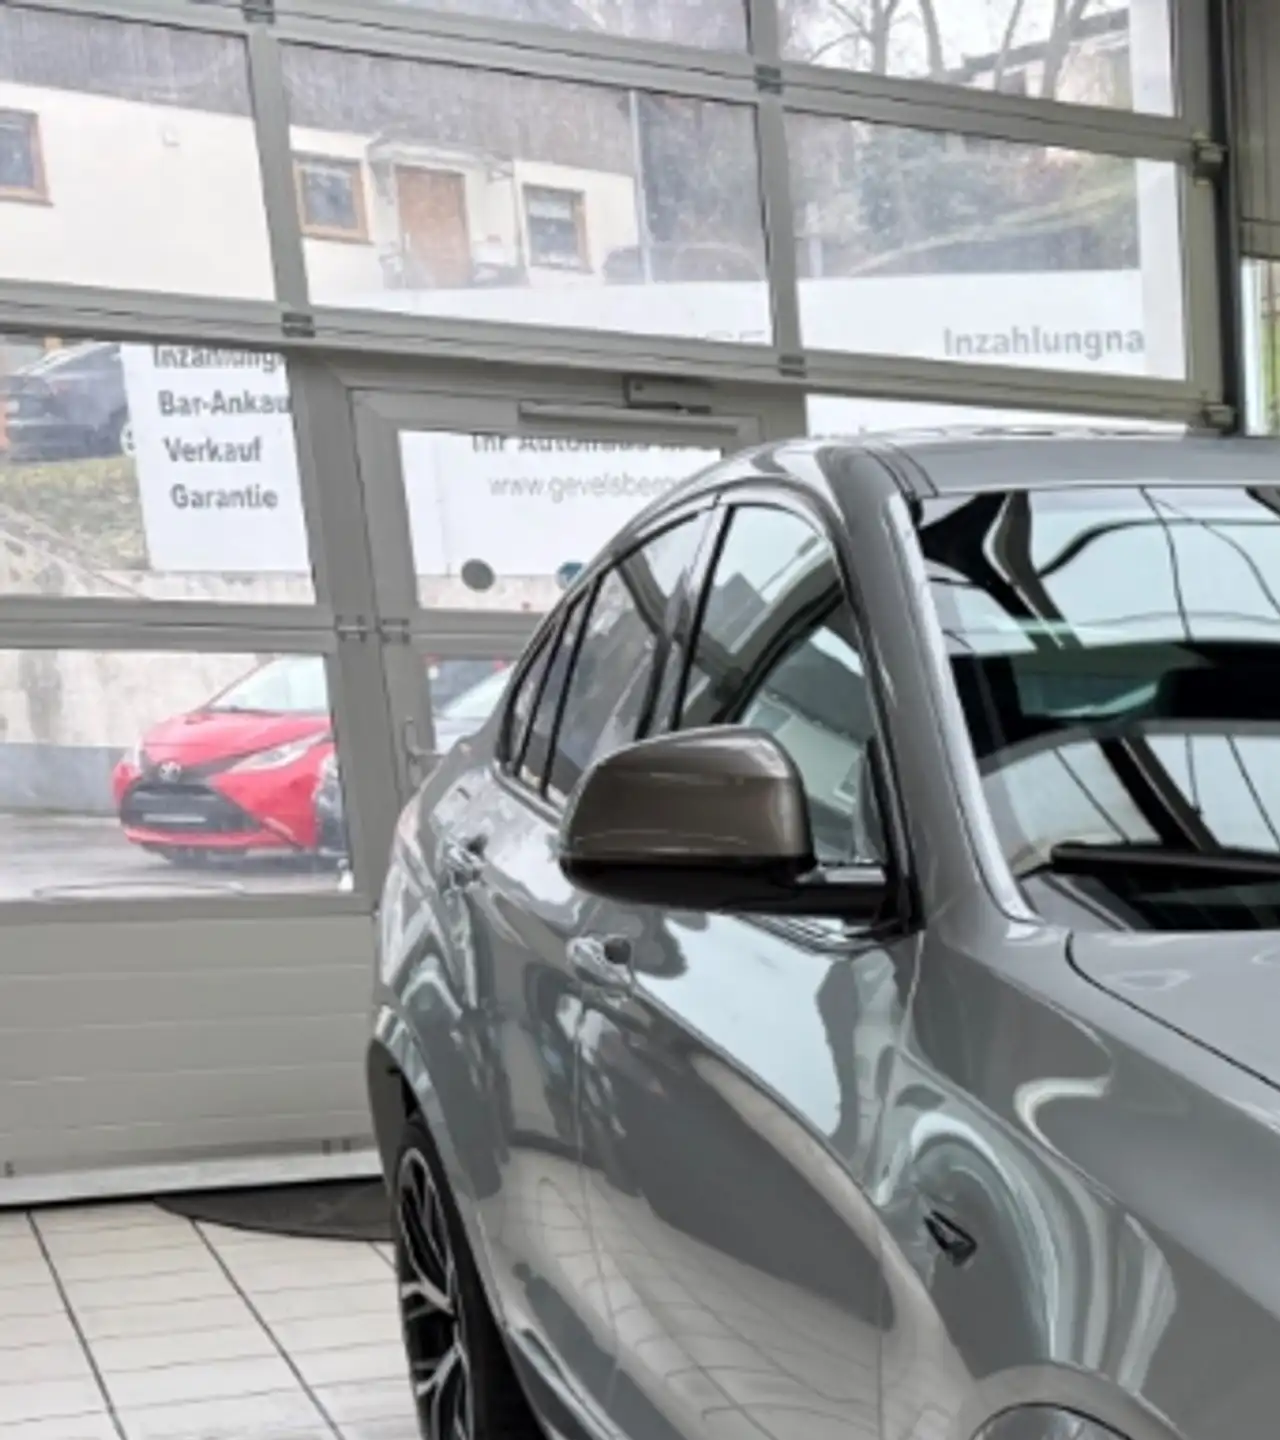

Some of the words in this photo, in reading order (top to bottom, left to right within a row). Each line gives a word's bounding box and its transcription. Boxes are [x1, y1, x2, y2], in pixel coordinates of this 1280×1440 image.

[943, 325, 1146, 361] Inzahlungna
[164, 437, 262, 462] Verkauf
[170, 483, 279, 509] Garantie
